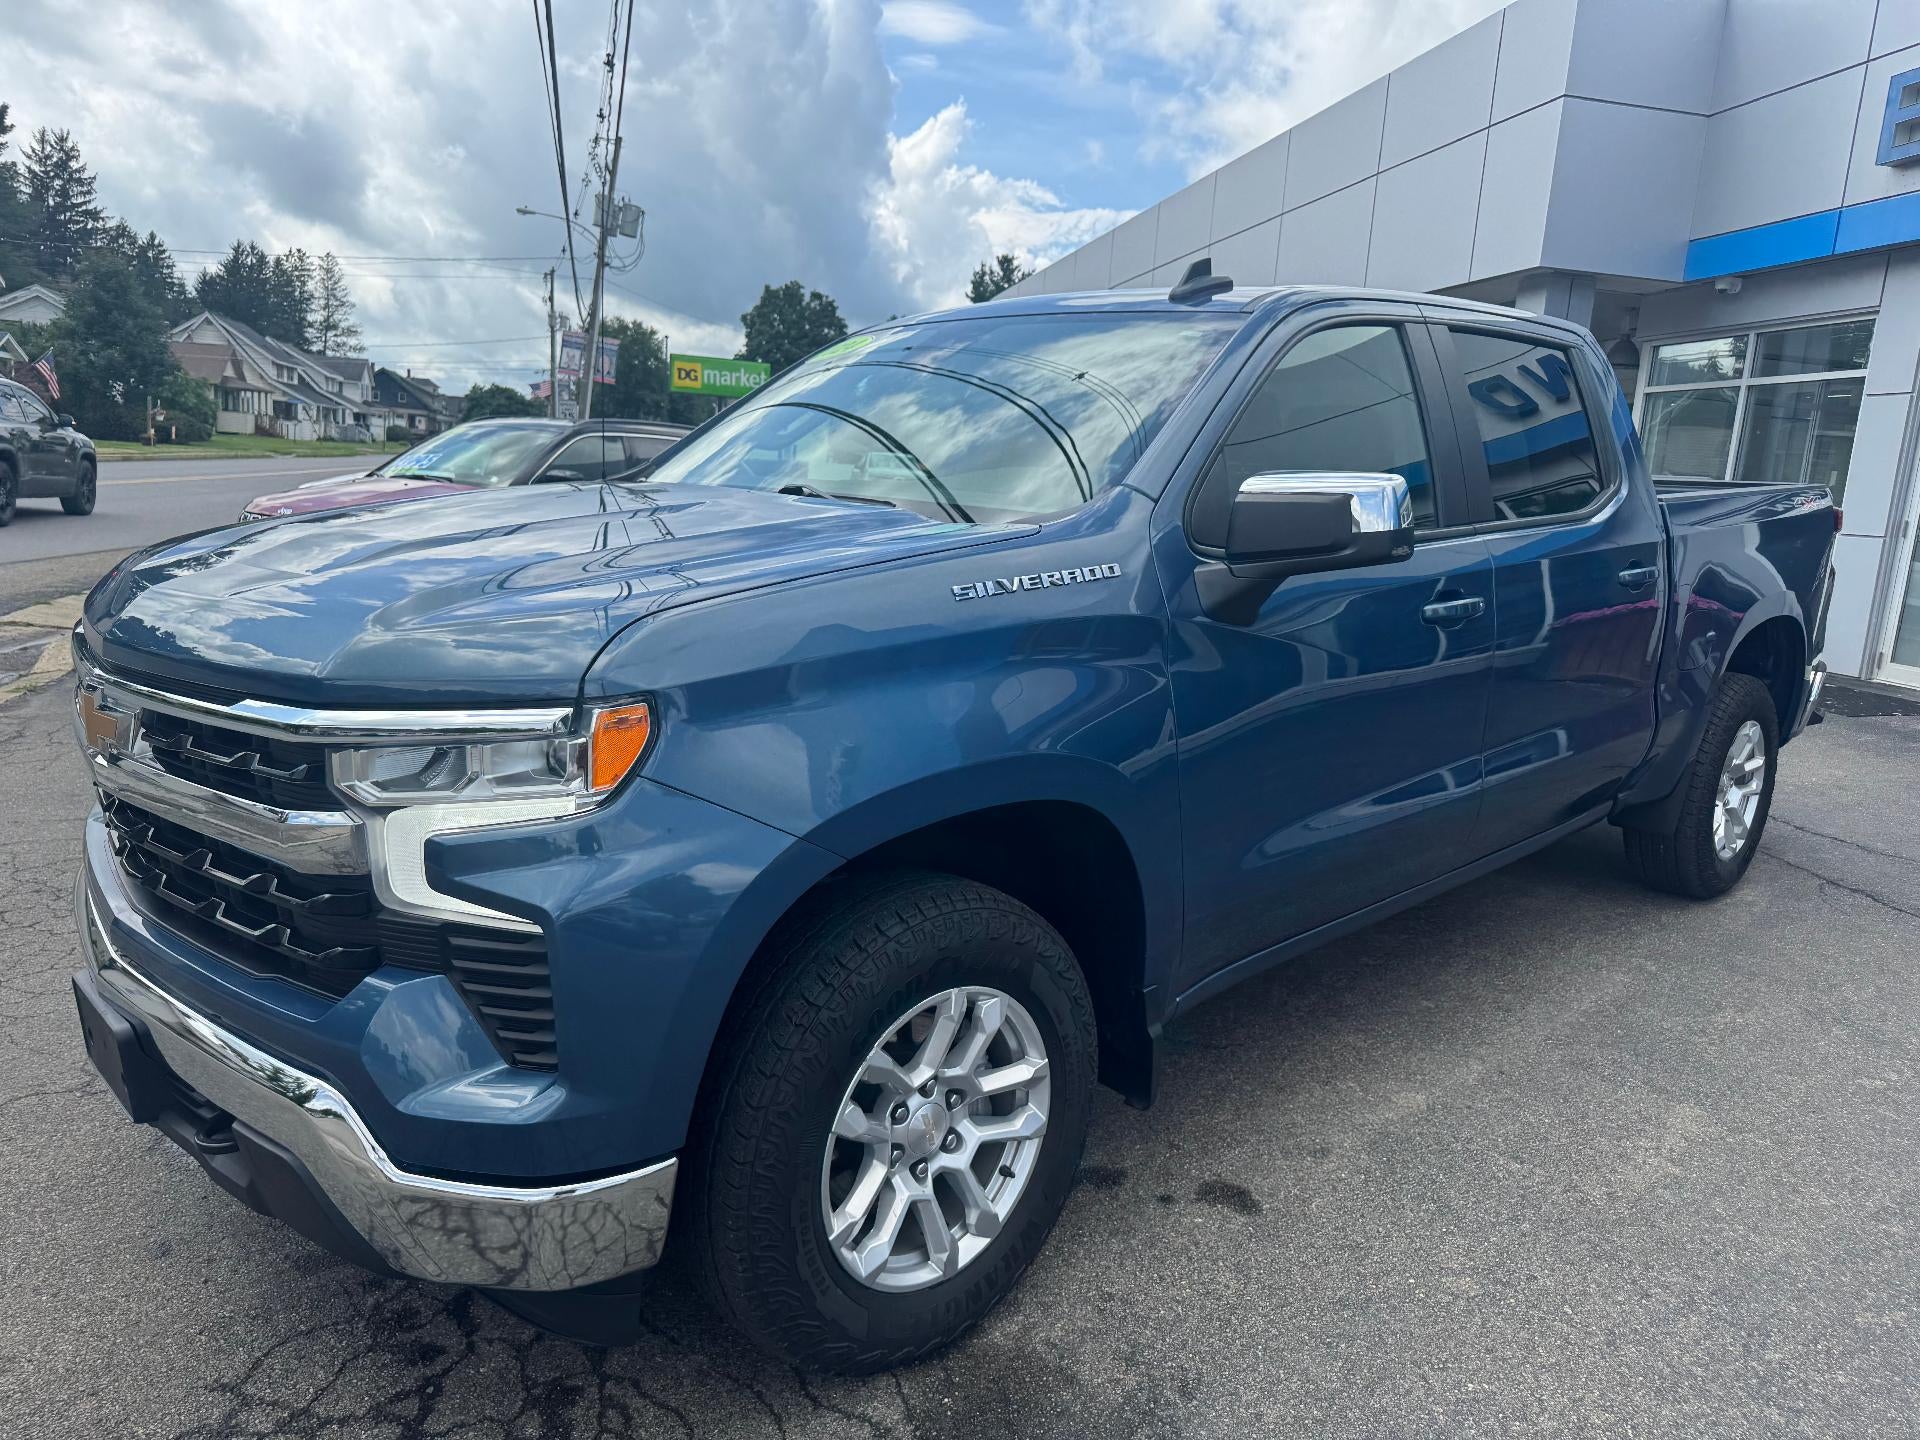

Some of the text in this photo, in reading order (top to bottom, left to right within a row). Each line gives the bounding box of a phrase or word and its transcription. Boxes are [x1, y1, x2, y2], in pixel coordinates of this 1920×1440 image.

[677, 367, 767, 388] DG market
[952, 563, 1121, 601] SILVERADO
